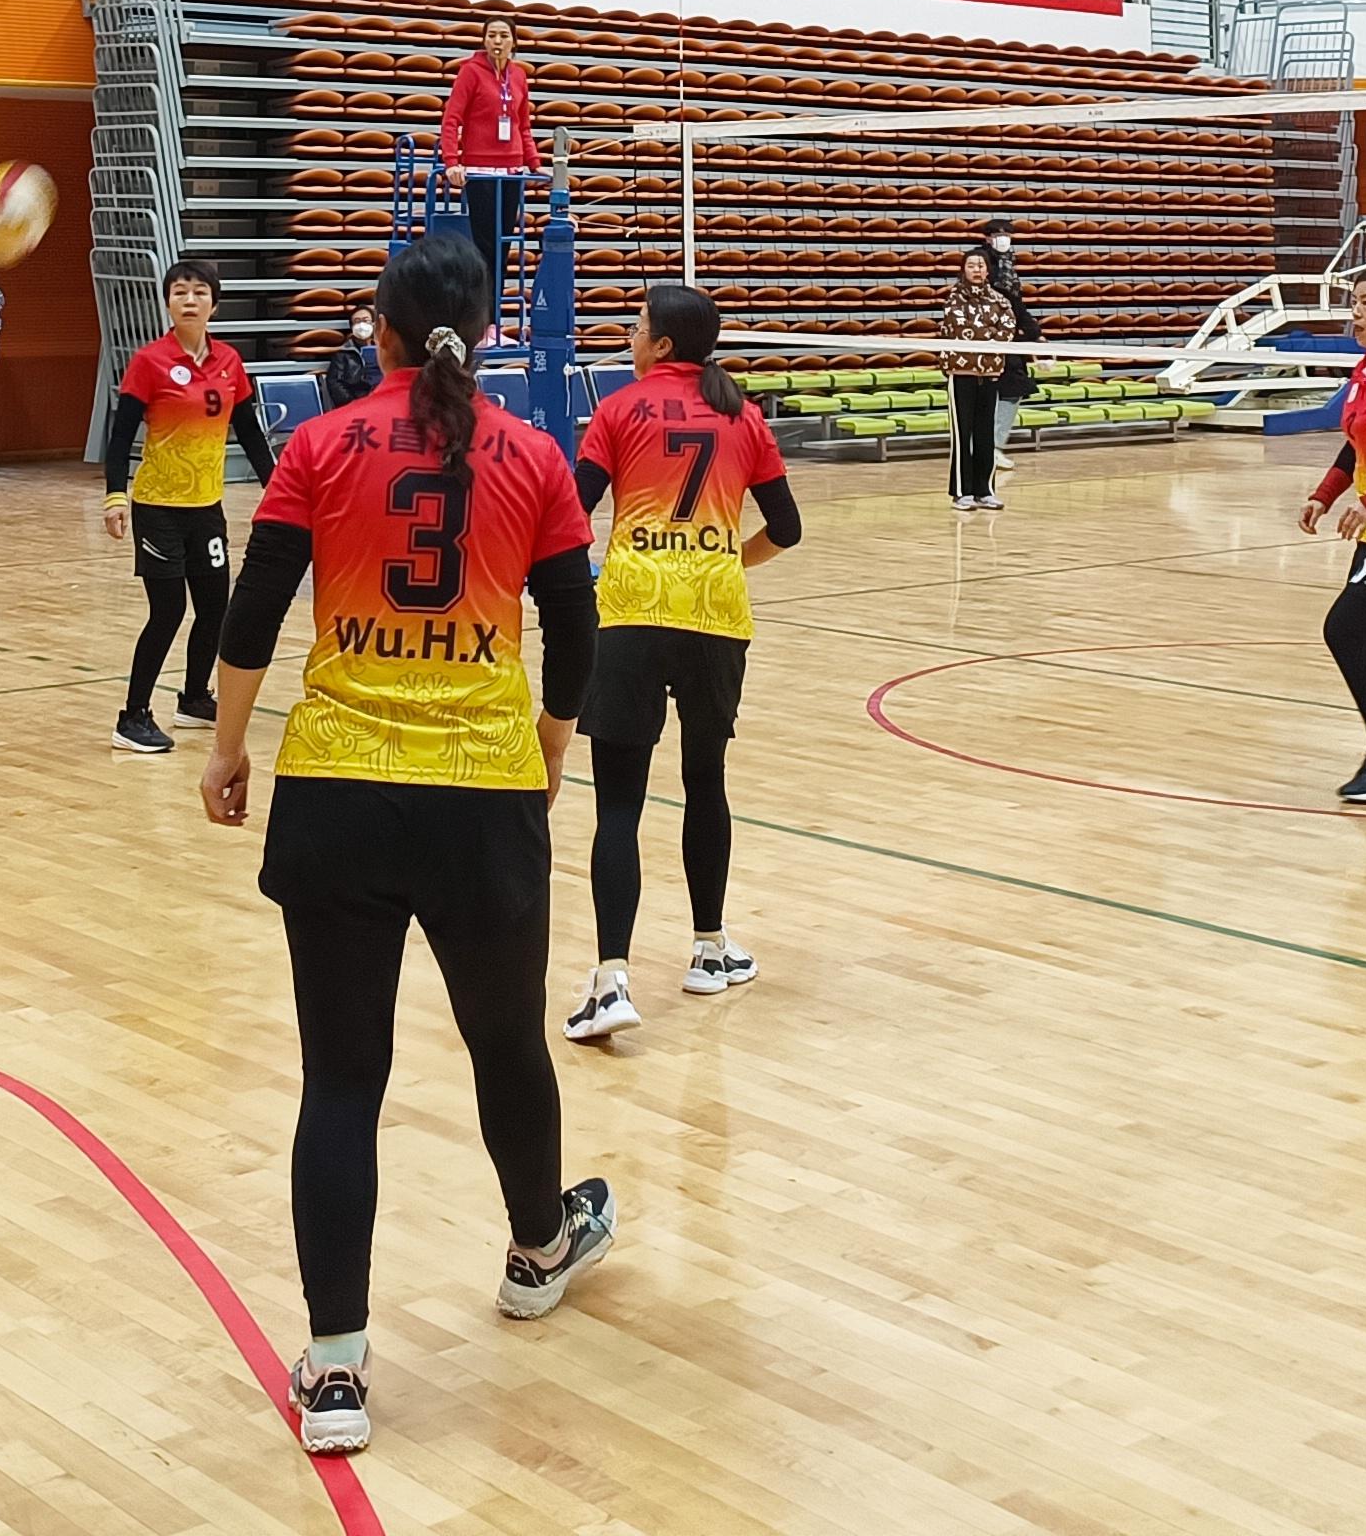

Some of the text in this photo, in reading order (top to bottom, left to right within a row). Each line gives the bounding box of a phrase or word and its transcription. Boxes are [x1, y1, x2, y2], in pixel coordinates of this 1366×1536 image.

[204, 389, 222, 417] 9
[632, 397, 743, 426] 永昌二
[341, 418, 520, 463] 永昌小
[663, 427, 719, 523] 7
[208, 536, 226, 568] 9
[382, 467, 473, 614] 3
[334, 615, 499, 664] Wu.H.X
